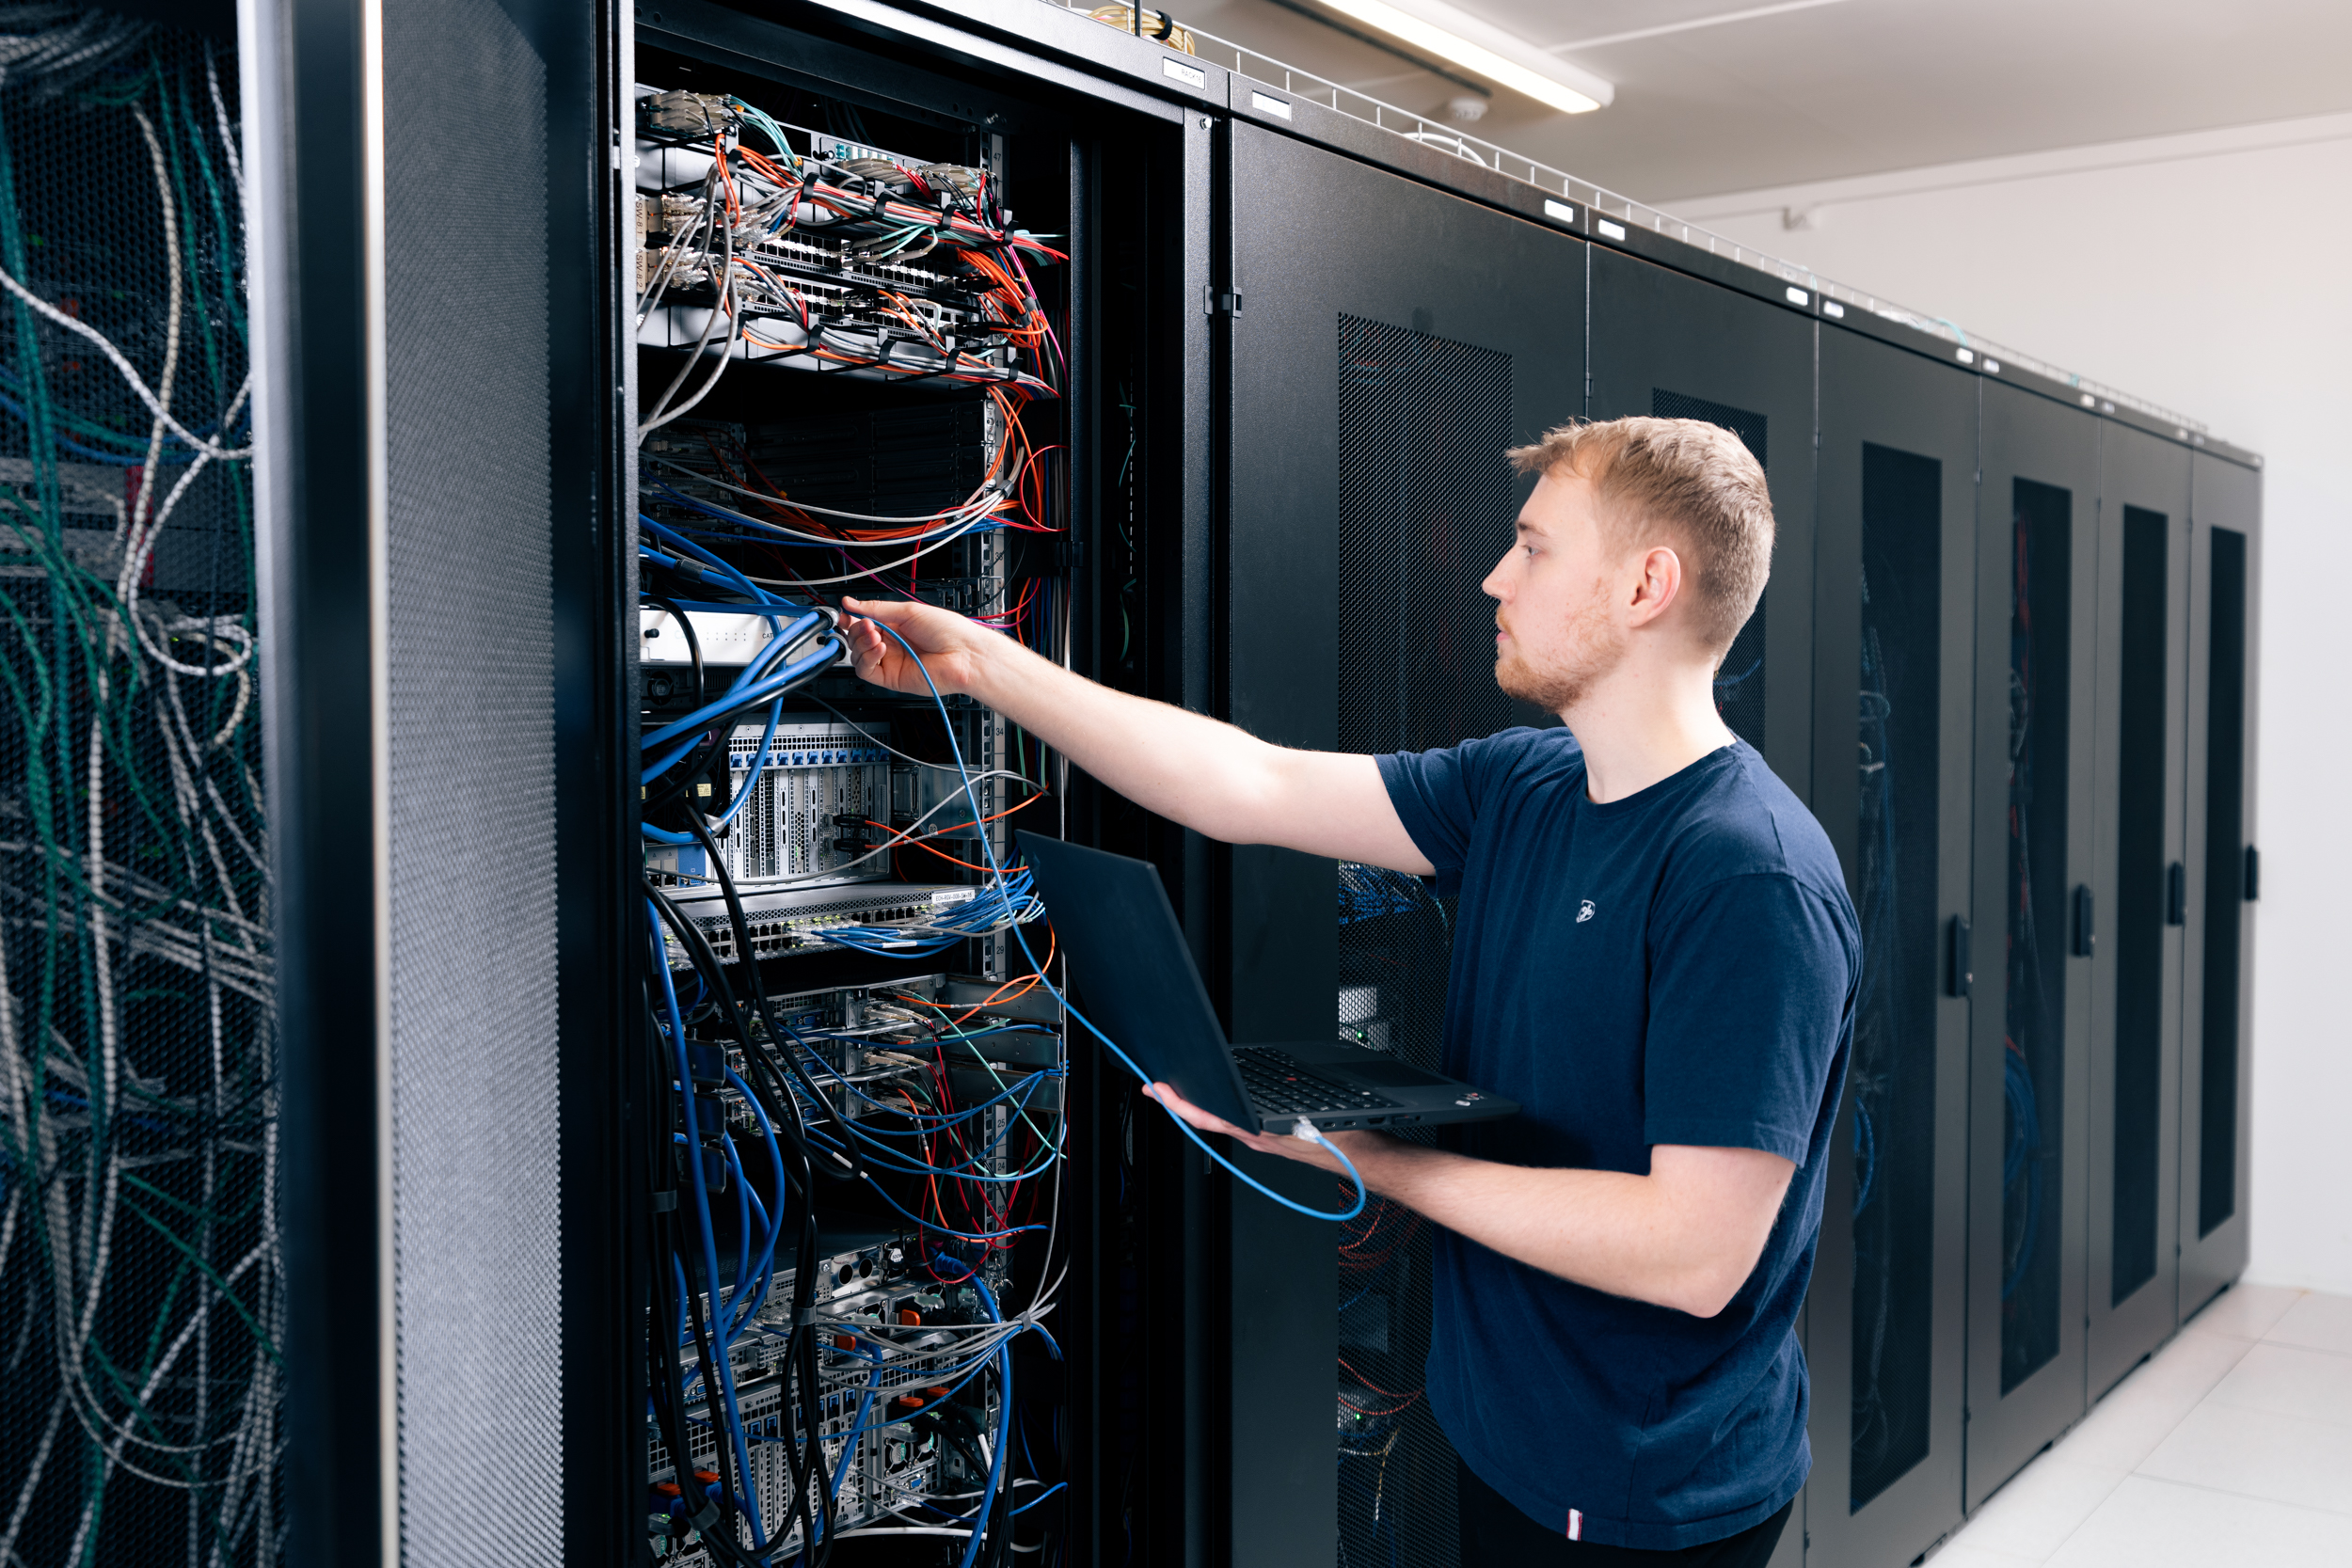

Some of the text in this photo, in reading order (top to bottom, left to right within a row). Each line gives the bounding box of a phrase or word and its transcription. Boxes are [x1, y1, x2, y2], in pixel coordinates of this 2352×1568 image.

[1181, 69, 1202, 84] RACK16
[993, 152, 1002, 162] 47
[995, 420, 1003, 429] 41
[995, 727, 1004, 736] 34
[995, 859, 1004, 867] 31
[996, 945, 1005, 955] 29
[997, 1119, 1006, 1128] 25
[997, 1162, 1006, 1171] 24
[997, 1205, 1006, 1213] 23
